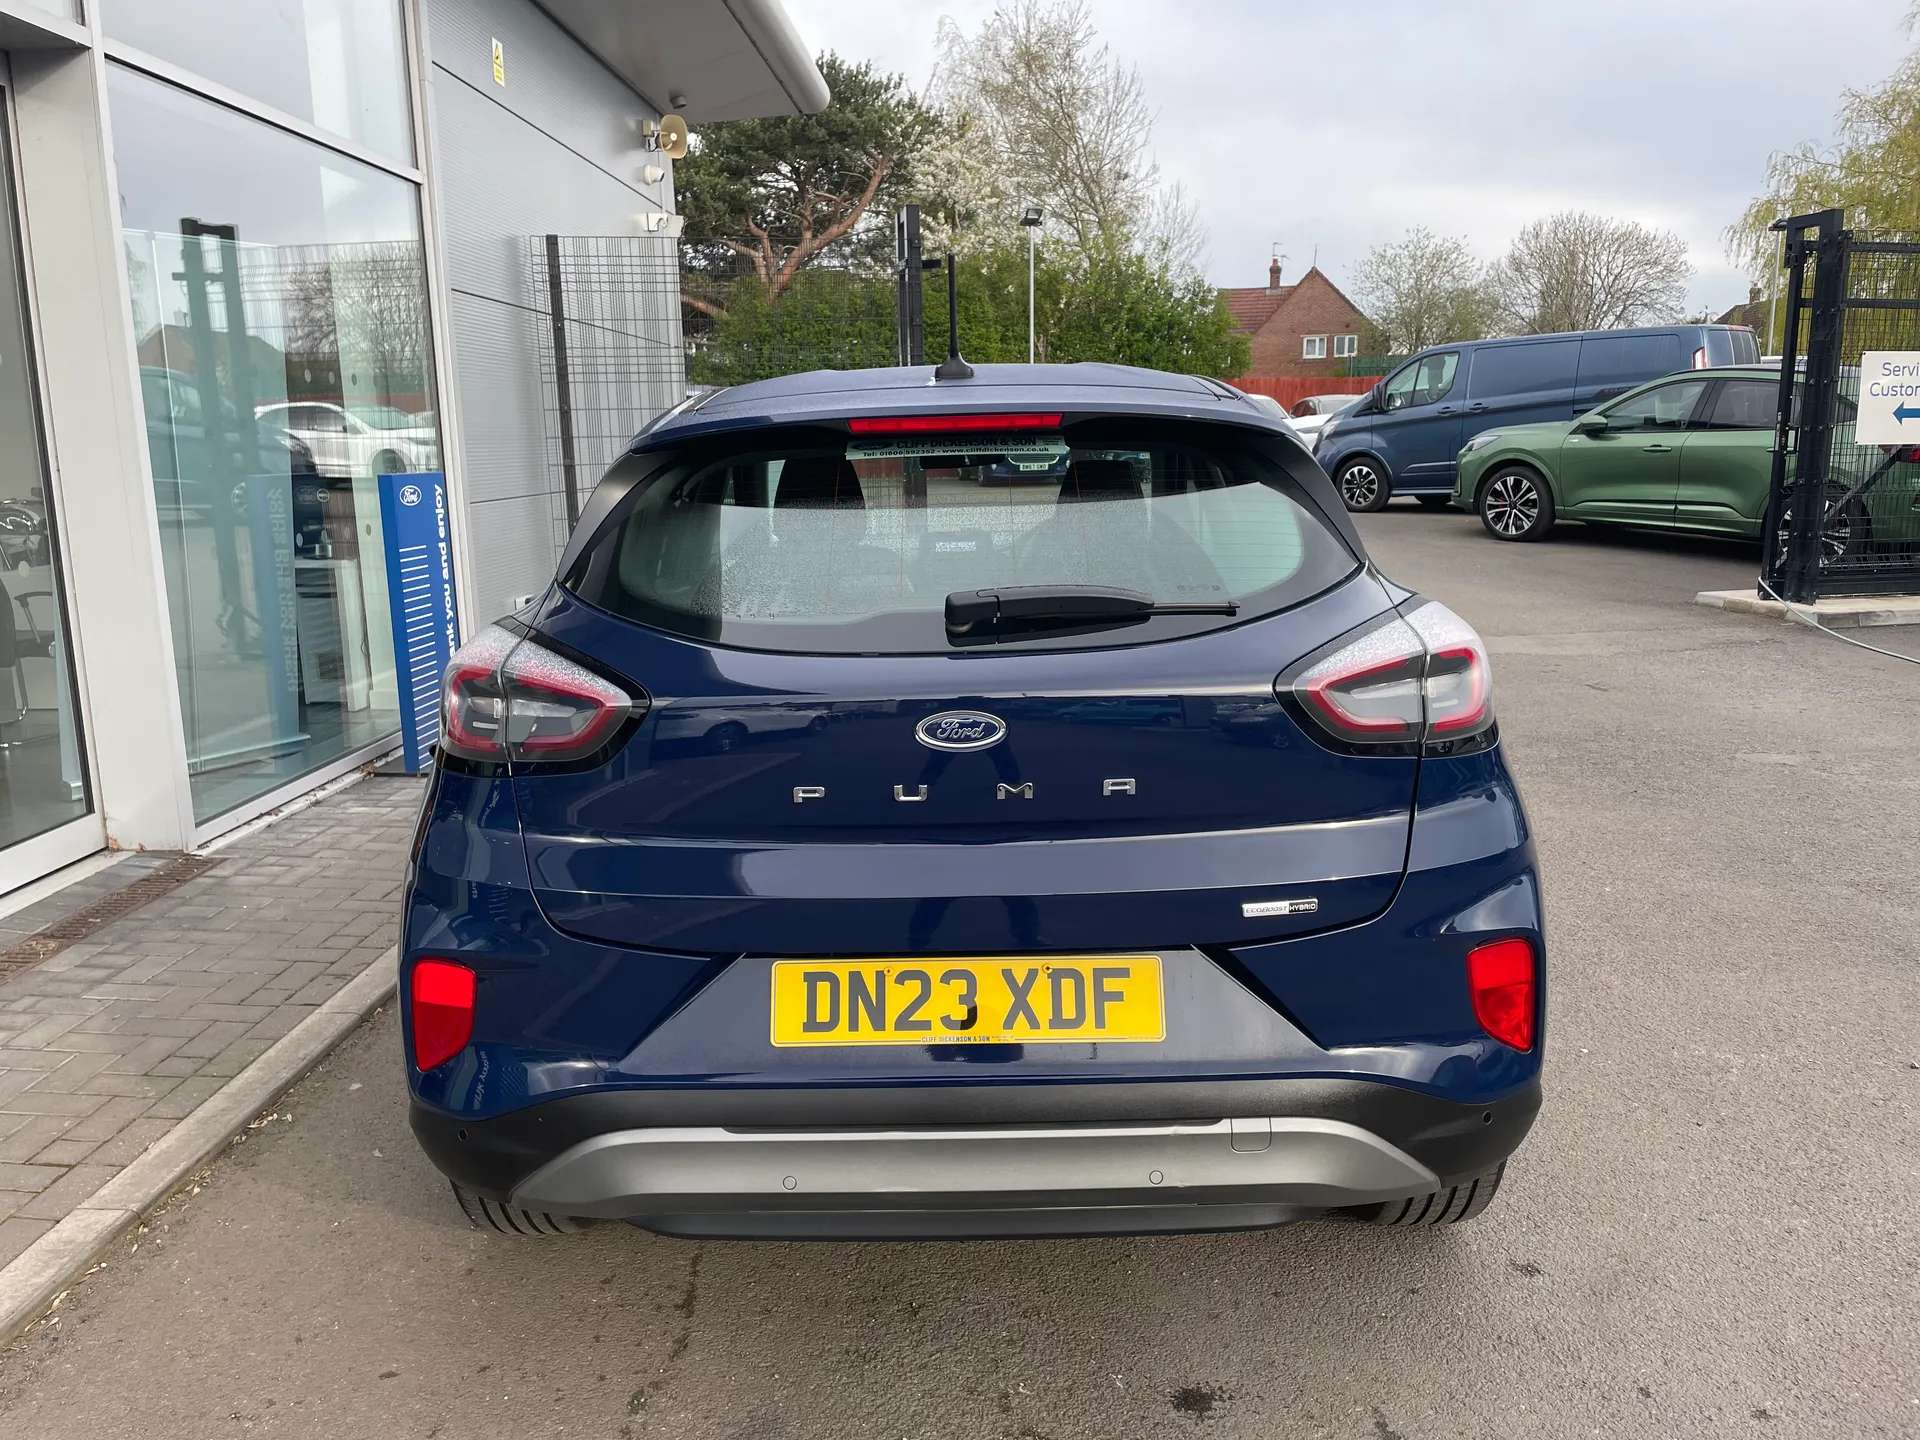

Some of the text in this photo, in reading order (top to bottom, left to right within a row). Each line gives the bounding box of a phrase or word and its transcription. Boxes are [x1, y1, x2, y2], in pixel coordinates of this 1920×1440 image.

[896, 440, 928, 449] CLIFF
[930, 437, 998, 448] DICKENSON
[999, 438, 1009, 447] &
[1011, 436, 1037, 446] SON
[434, 484, 446, 539] enjoy
[438, 541, 449, 581] and
[443, 583, 454, 621] you
[936, 718, 987, 739] Ford
[802, 967, 1131, 1033] DN23 XDF
